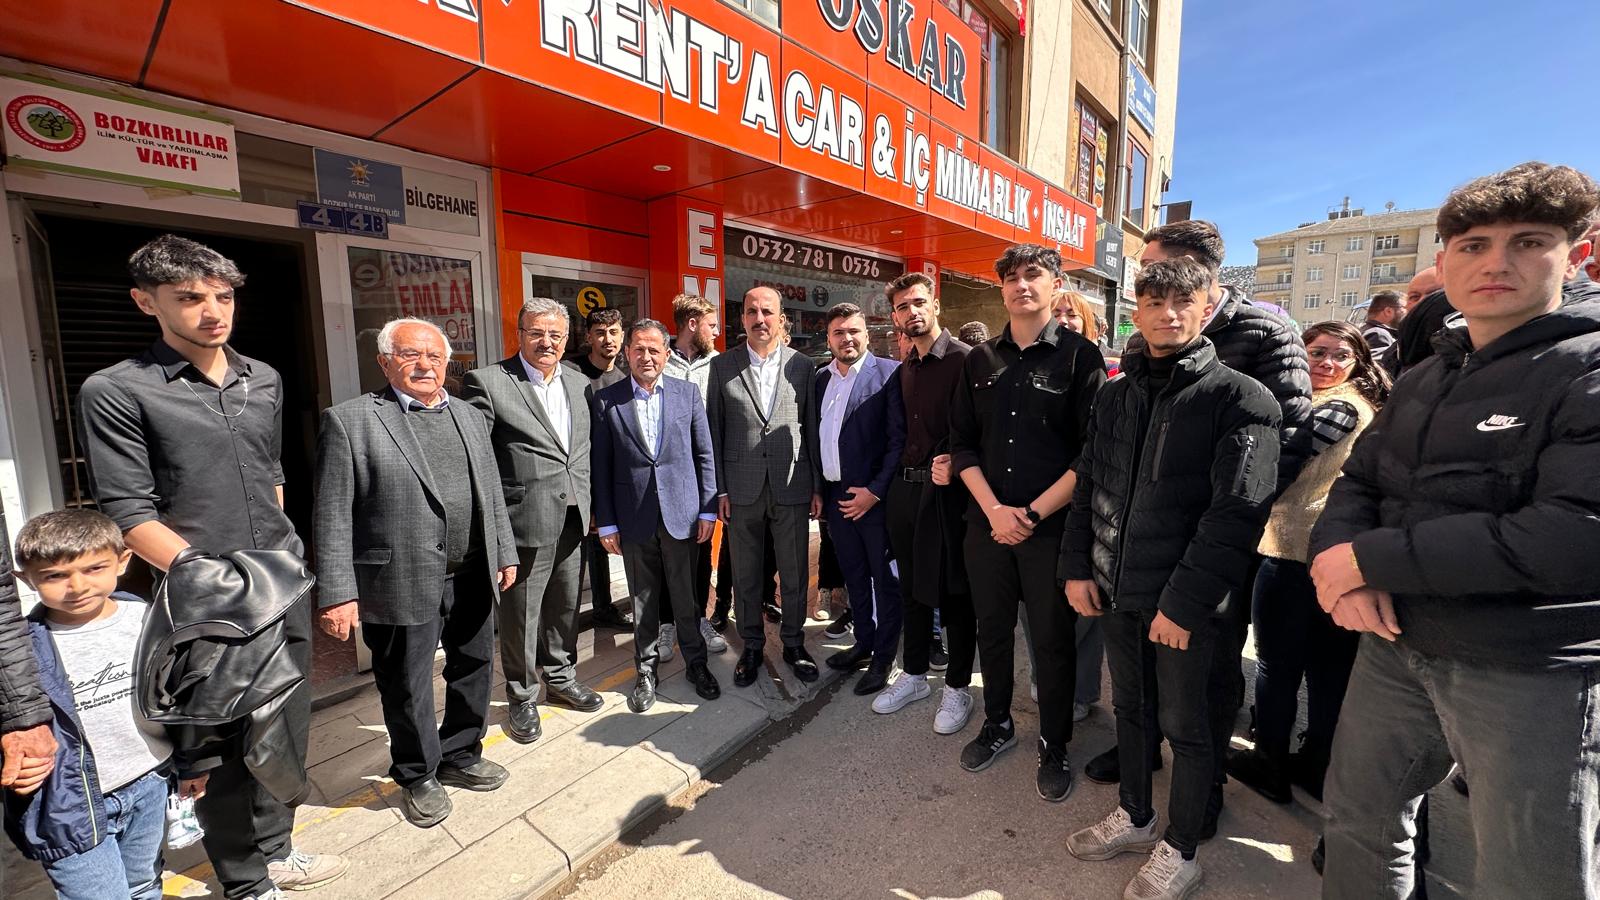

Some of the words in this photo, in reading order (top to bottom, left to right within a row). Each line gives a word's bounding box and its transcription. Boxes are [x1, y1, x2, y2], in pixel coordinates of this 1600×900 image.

[94, 111, 229, 153] BOZKIRLILAR
[118, 134, 156, 147] KÜLTÜR
[168, 144, 229, 161] YARDIMLAŞMA
[136, 146, 198, 172] VAKFI
[784, 70, 864, 170] CAR
[872, 113, 897, 182] &
[903, 107, 931, 207] İÇ
[934, 135, 1032, 232] MİMARLIK
[1041, 183, 1087, 253] İNŞAAT
[347, 190, 358, 199] AK
[405, 186, 478, 217] BİLGEHANE
[311, 206, 332, 227] 4
[742, 235, 796, 264] 0532
[801, 247, 833, 270] 781
[842, 255, 880, 278] 0536
[445, 318, 474, 340] Ofi
[1486, 414, 1519, 427] NIKE
